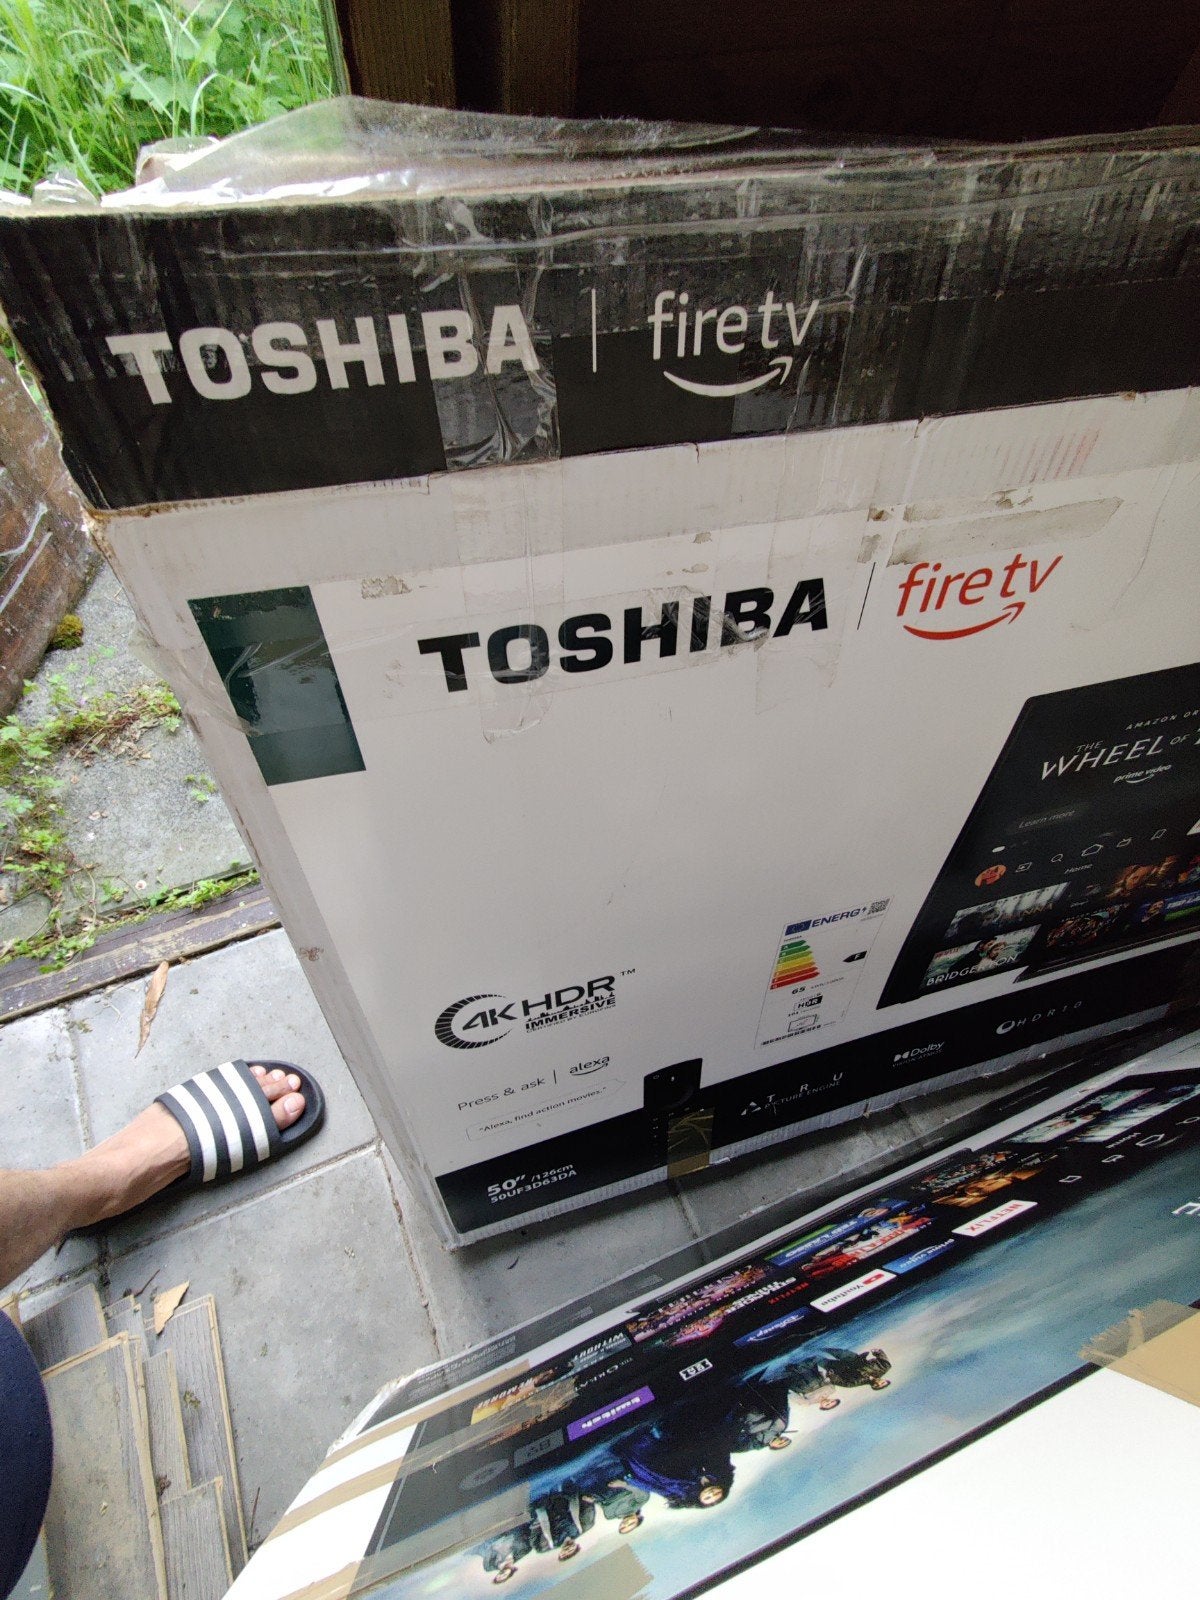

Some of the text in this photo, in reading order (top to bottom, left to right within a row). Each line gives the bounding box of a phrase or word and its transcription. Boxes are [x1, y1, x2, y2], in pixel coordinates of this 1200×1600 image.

[105, 290, 820, 405] TOSHIBA fire tv
[417, 553, 1064, 693] TOSHIBA fire tv
[1125, 714, 1178, 731] AMAZON
[1041, 735, 1164, 781] WHEEL
[1169, 733, 1191, 745] OF
[1076, 740, 1103, 753] THE
[1113, 764, 1172, 784] prime video
[1019, 816, 1047, 829] Learn
[1064, 863, 1093, 875] Home
[462, 1002, 518, 1031] 4K
[521, 975, 616, 1018] HDR
[525, 998, 616, 1031] IMMERSIVE
[910, 1041, 945, 1057] Dolby
[458, 1055, 611, 1111] Press & ask alexa
[514, 1111, 534, 1122] find
[535, 1101, 565, 1114] action
[967, 1202, 1023, 1232] NETFLIX
[819, 1281, 866, 1308] YouTube
[581, 1396, 641, 1430] twitch
